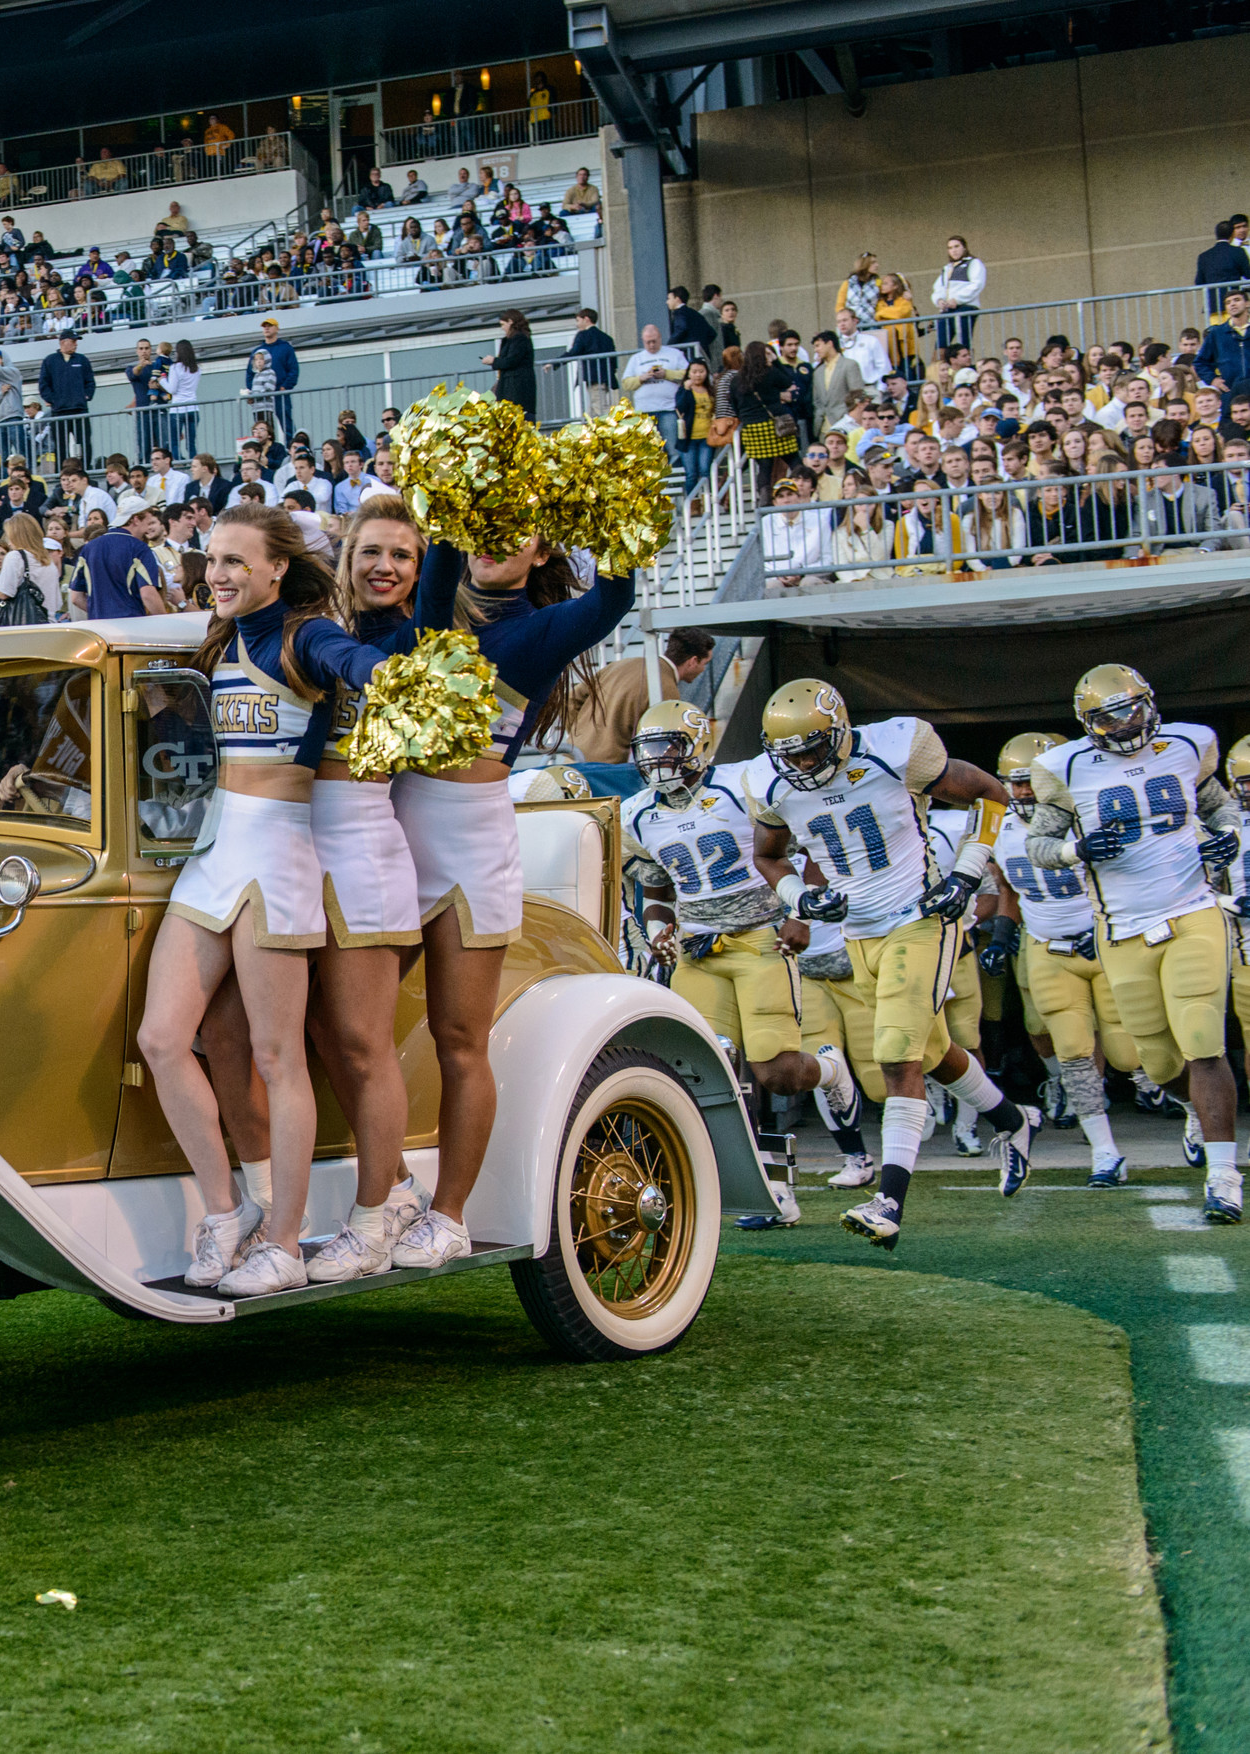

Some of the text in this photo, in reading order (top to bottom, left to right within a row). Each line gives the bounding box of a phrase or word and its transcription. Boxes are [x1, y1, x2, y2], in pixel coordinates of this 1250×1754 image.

[1123, 766, 1146, 778] TECH
[823, 794, 846, 806] TECH
[677, 821, 696, 832] TECH
[806, 802, 891, 877] 11
